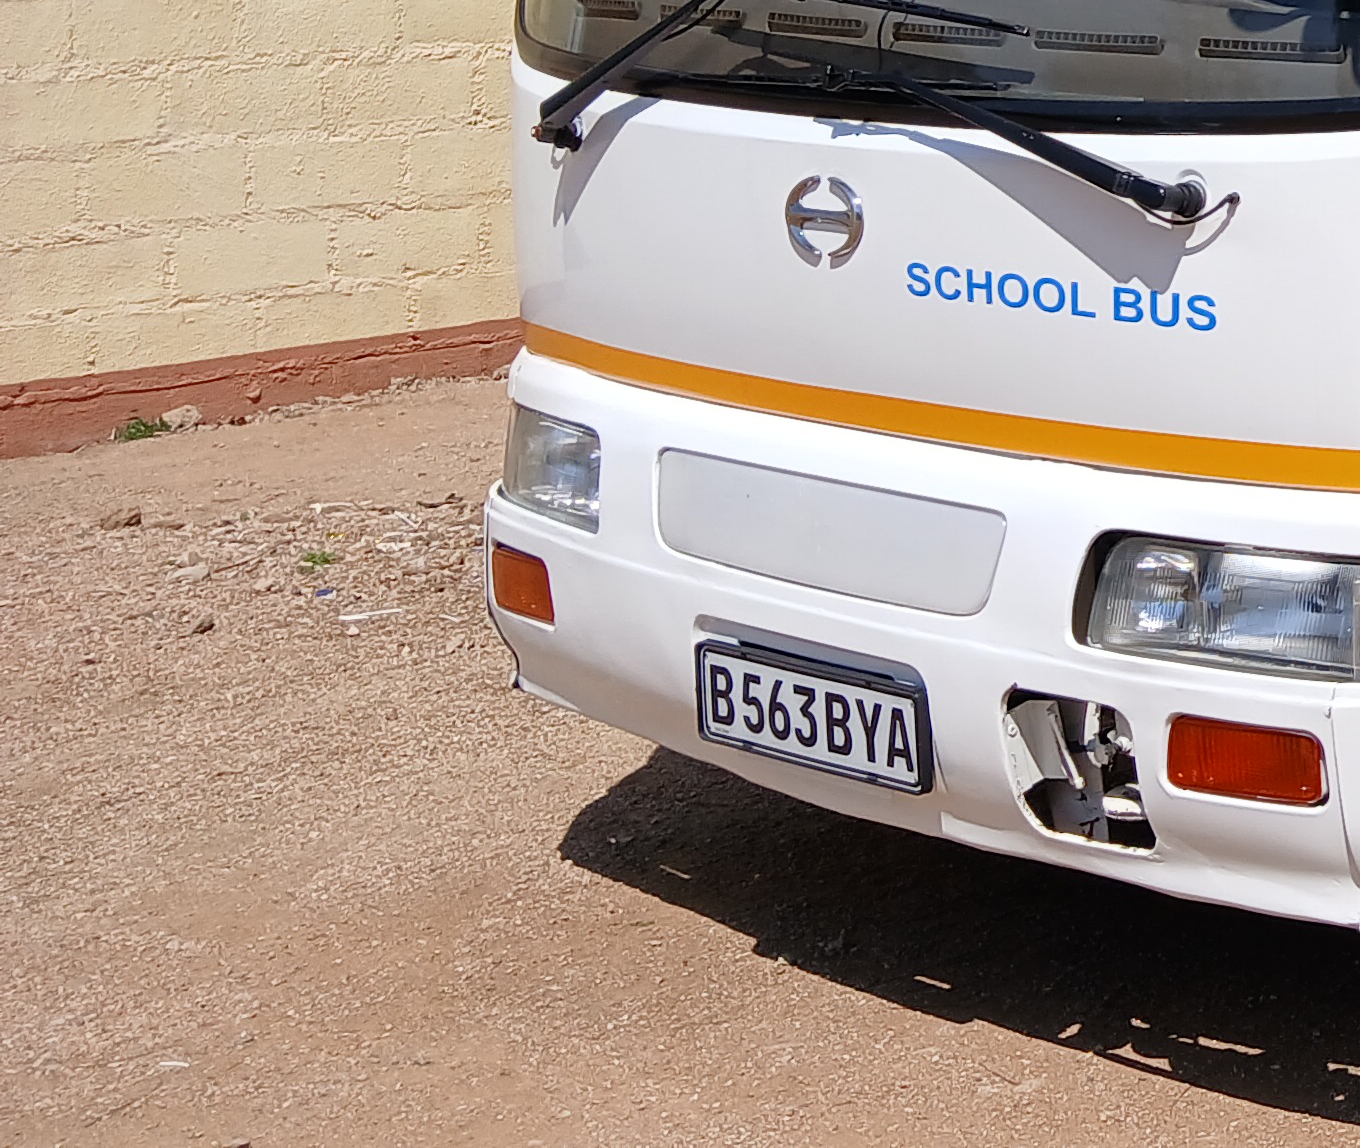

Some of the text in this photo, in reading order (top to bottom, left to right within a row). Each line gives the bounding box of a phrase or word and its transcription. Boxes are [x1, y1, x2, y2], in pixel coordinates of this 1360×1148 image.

[906, 261, 1218, 332] SCHOOL BUS
[709, 664, 915, 774] B563BYA
